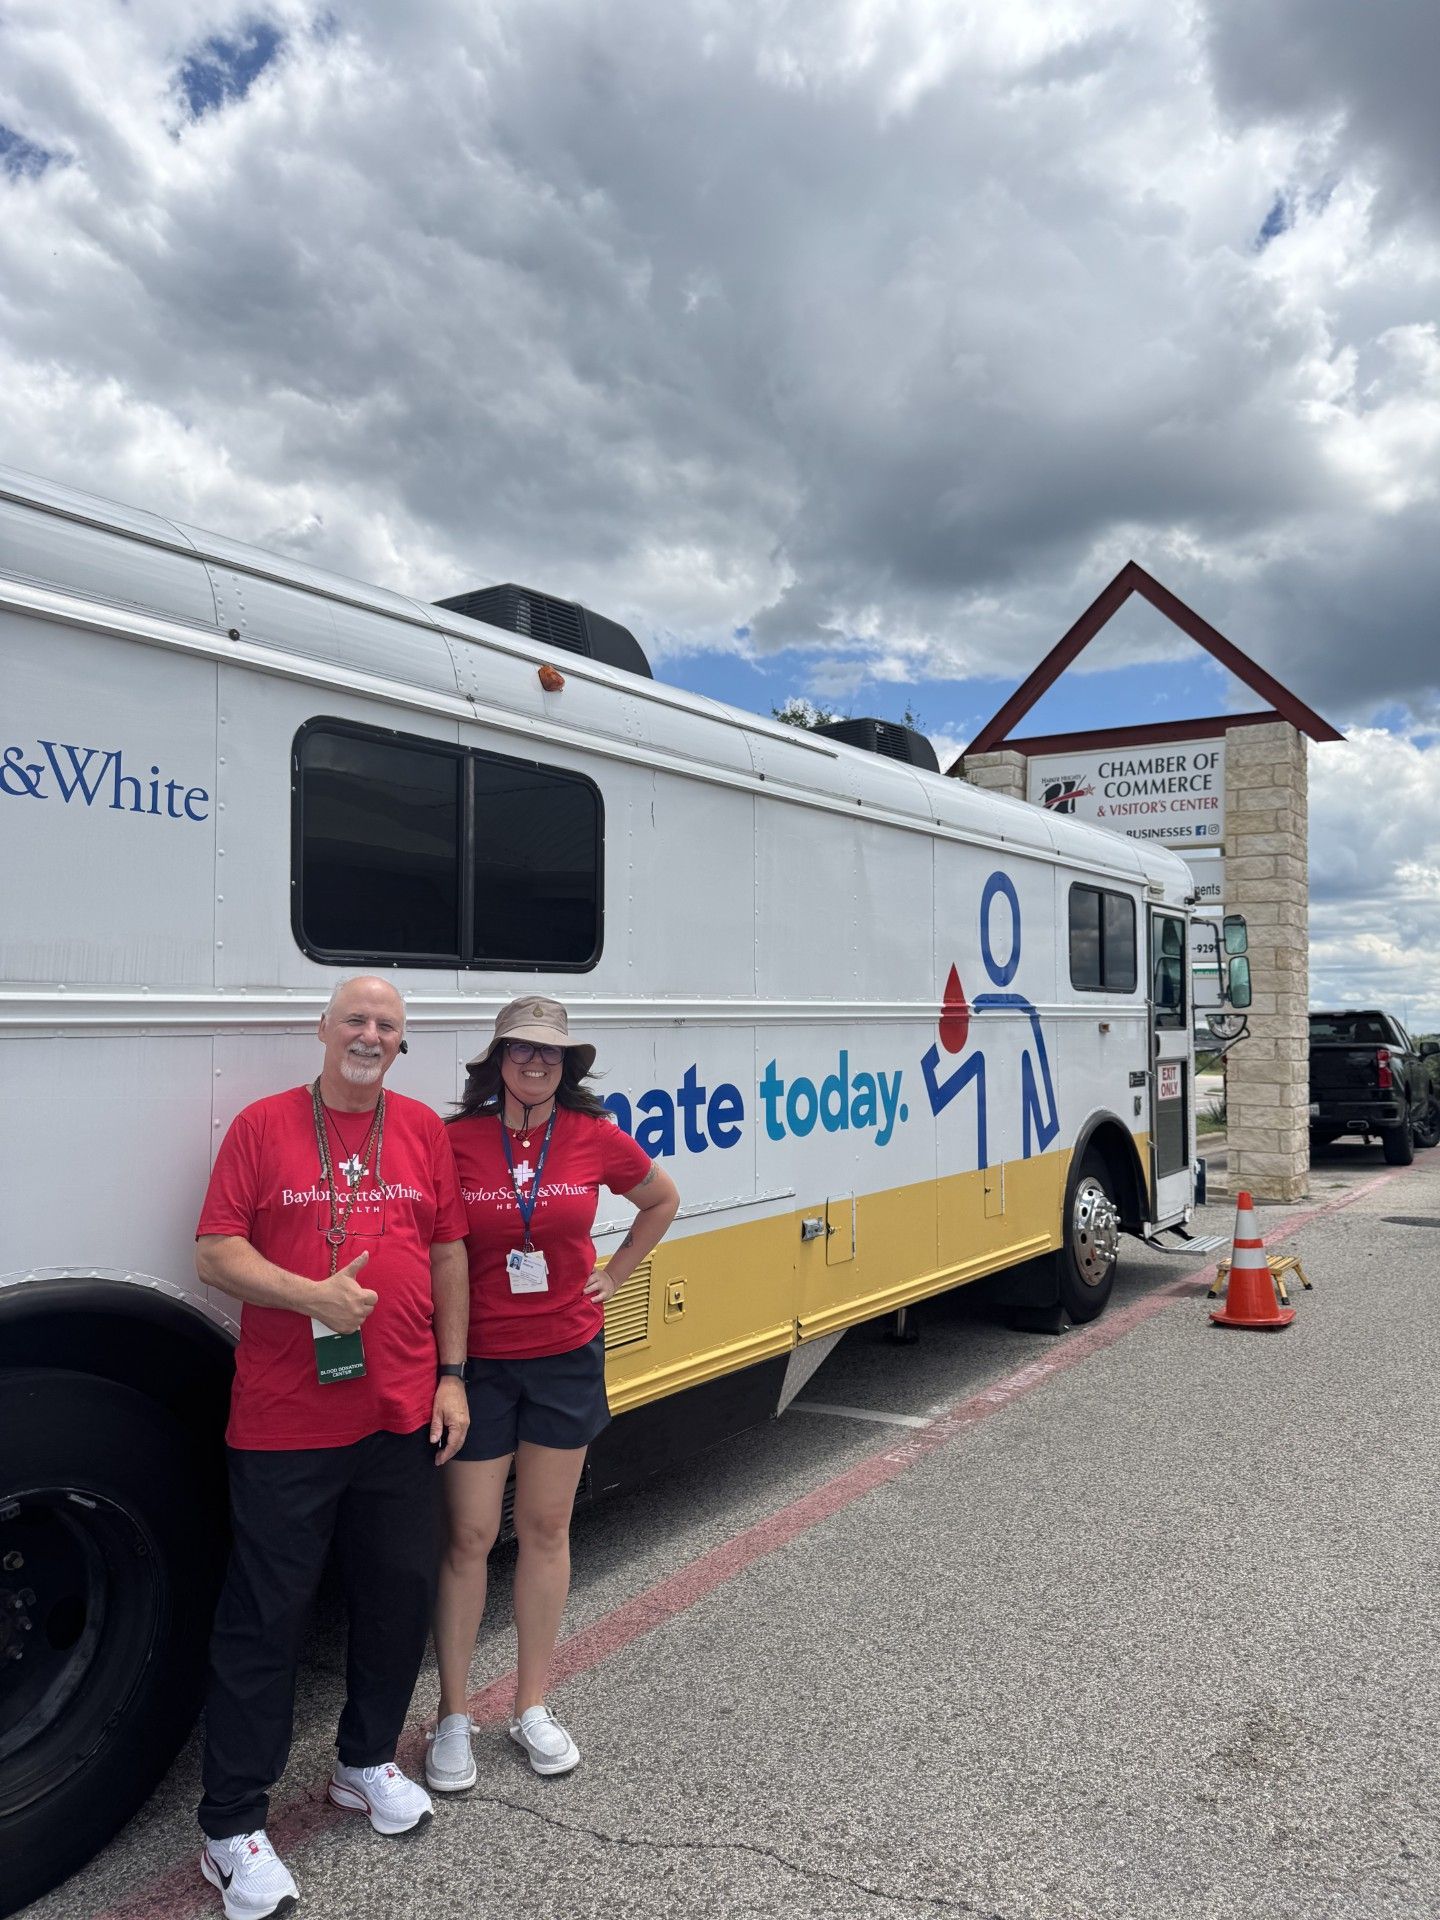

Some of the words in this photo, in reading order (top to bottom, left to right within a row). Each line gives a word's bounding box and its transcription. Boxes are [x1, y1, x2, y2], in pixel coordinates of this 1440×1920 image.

[1098, 755, 1187, 779] CHAMBER
[1193, 752, 1220, 771] OF
[0, 740, 209, 821] &White
[1104, 774, 1213, 799] COMMERCE
[1096, 805, 1106, 818] &
[1109, 799, 1167, 817] VISITOR'S
[1170, 796, 1220, 812] CENTER
[1126, 826, 1192, 839] BUSINESSES
[1191, 943, 1217, 954] -929
[1162, 1067, 1177, 1081] EXIT
[759, 1050, 909, 1147] today.
[1160, 1081, 1179, 1097] ONLY
